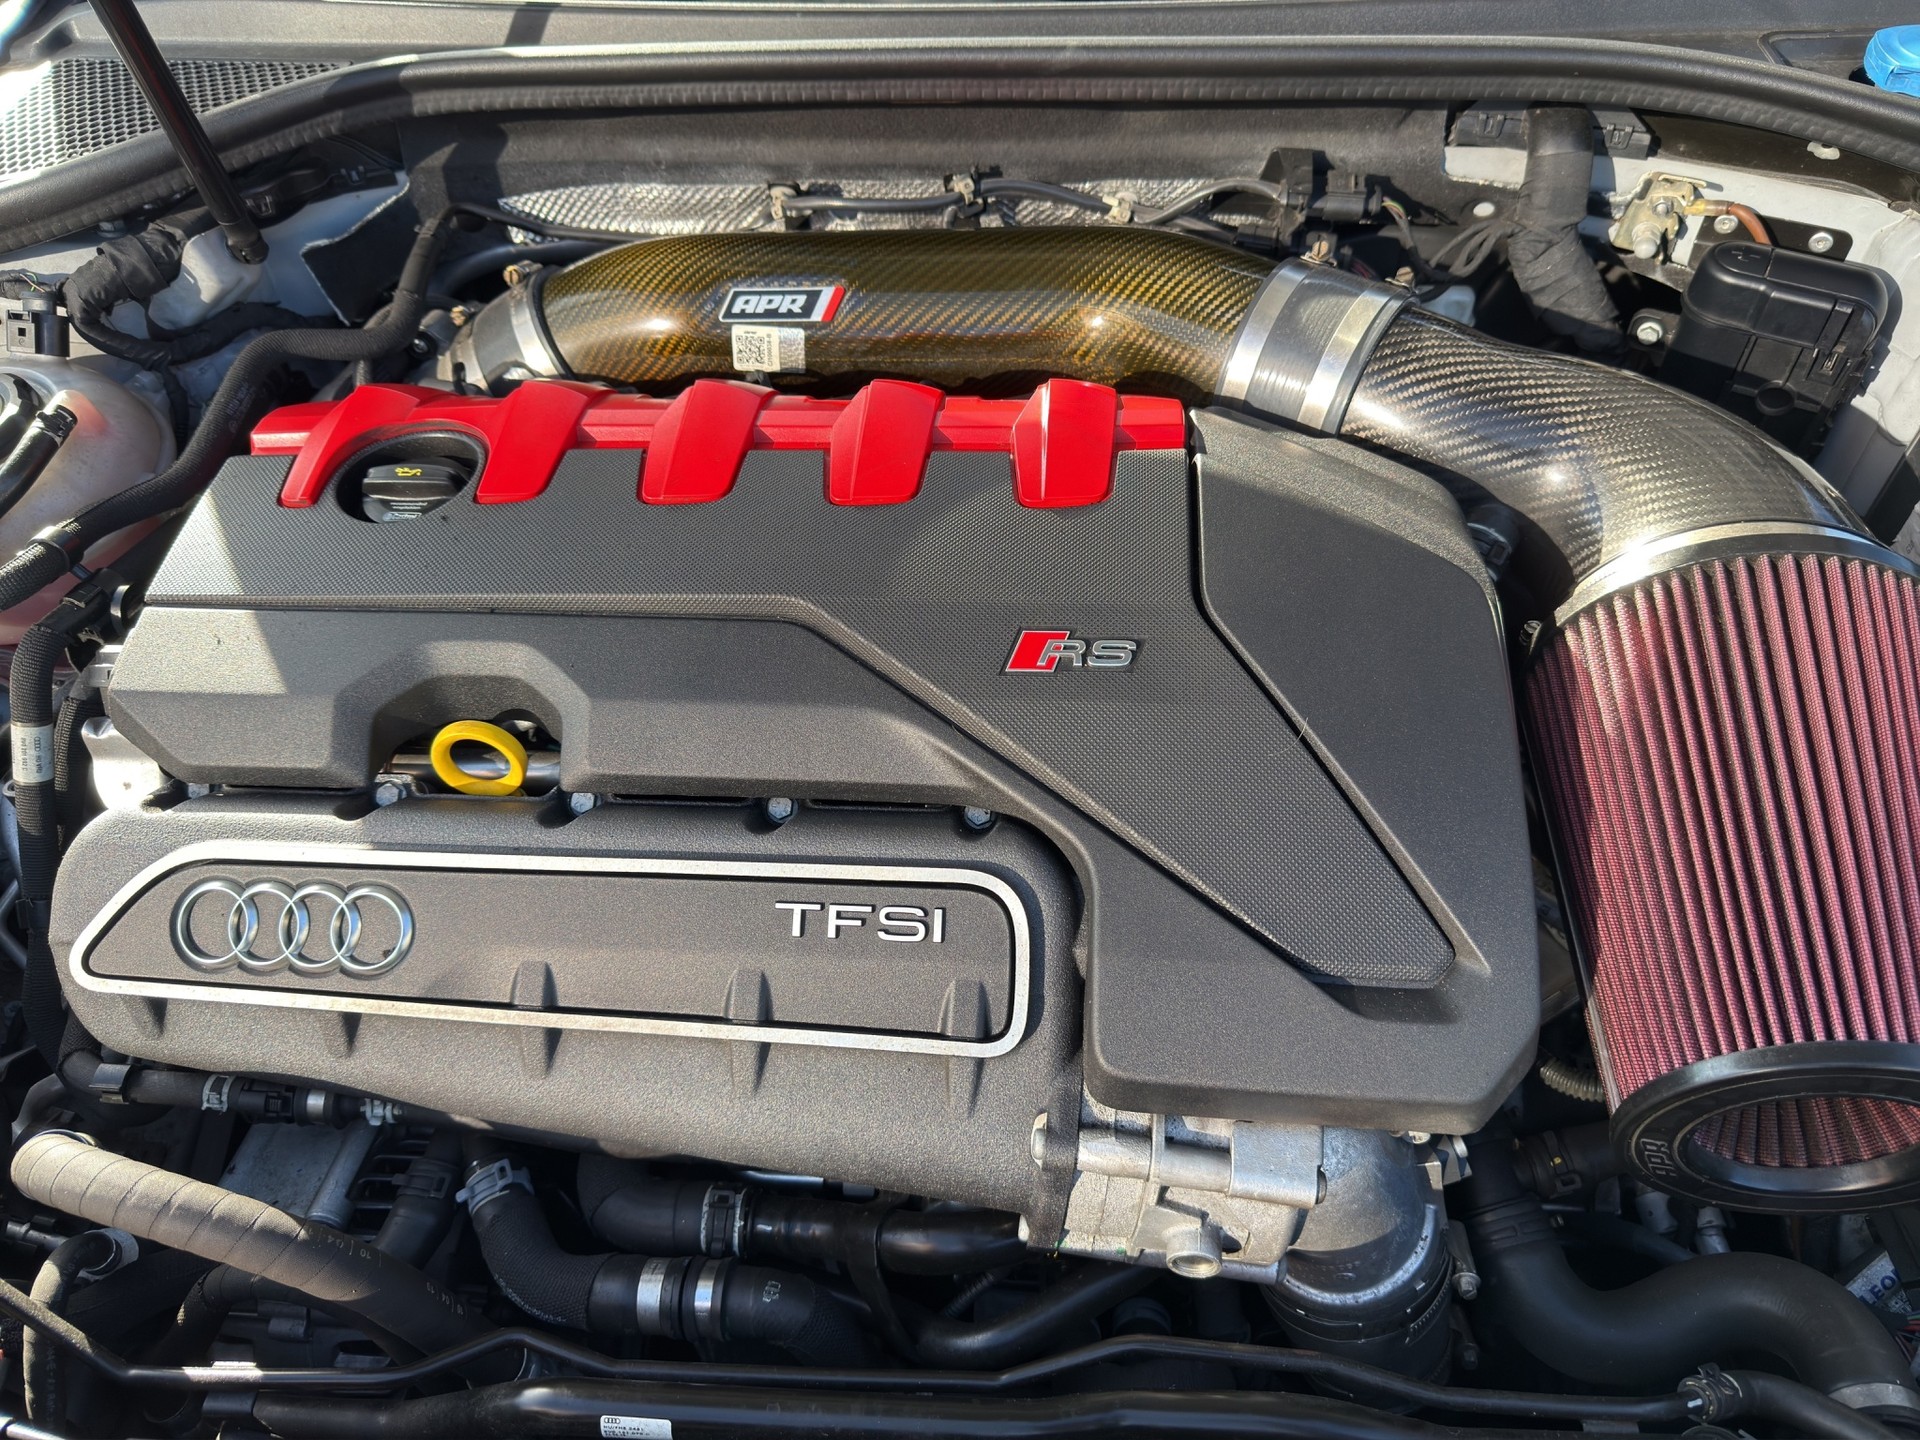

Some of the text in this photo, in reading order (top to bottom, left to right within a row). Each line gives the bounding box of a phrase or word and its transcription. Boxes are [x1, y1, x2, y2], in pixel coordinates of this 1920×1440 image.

[731, 294, 807, 314] APR
[1034, 637, 1138, 668] RS
[775, 902, 945, 943] TFSI
[1639, 1138, 1677, 1177] APR
